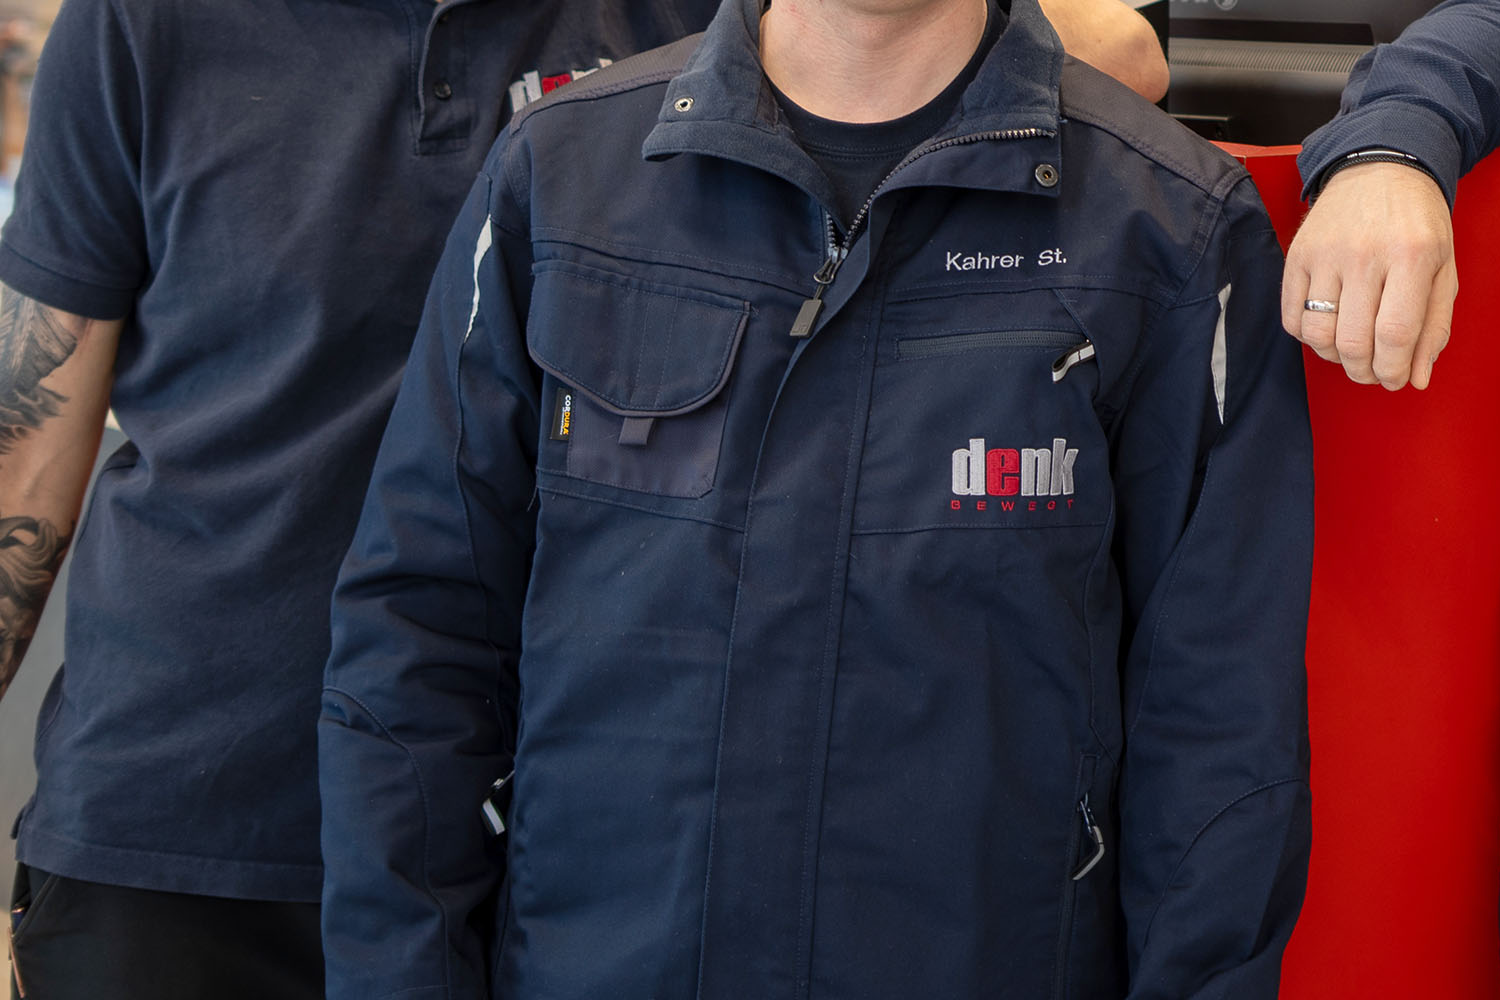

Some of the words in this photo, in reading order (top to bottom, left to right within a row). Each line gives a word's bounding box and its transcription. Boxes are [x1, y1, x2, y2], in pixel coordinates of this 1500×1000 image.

[946, 251, 1025, 271] Kahrer
[1037, 247, 1067, 266] St.
[951, 437, 1080, 496] denk
[950, 500, 1075, 512] BEWEGT
